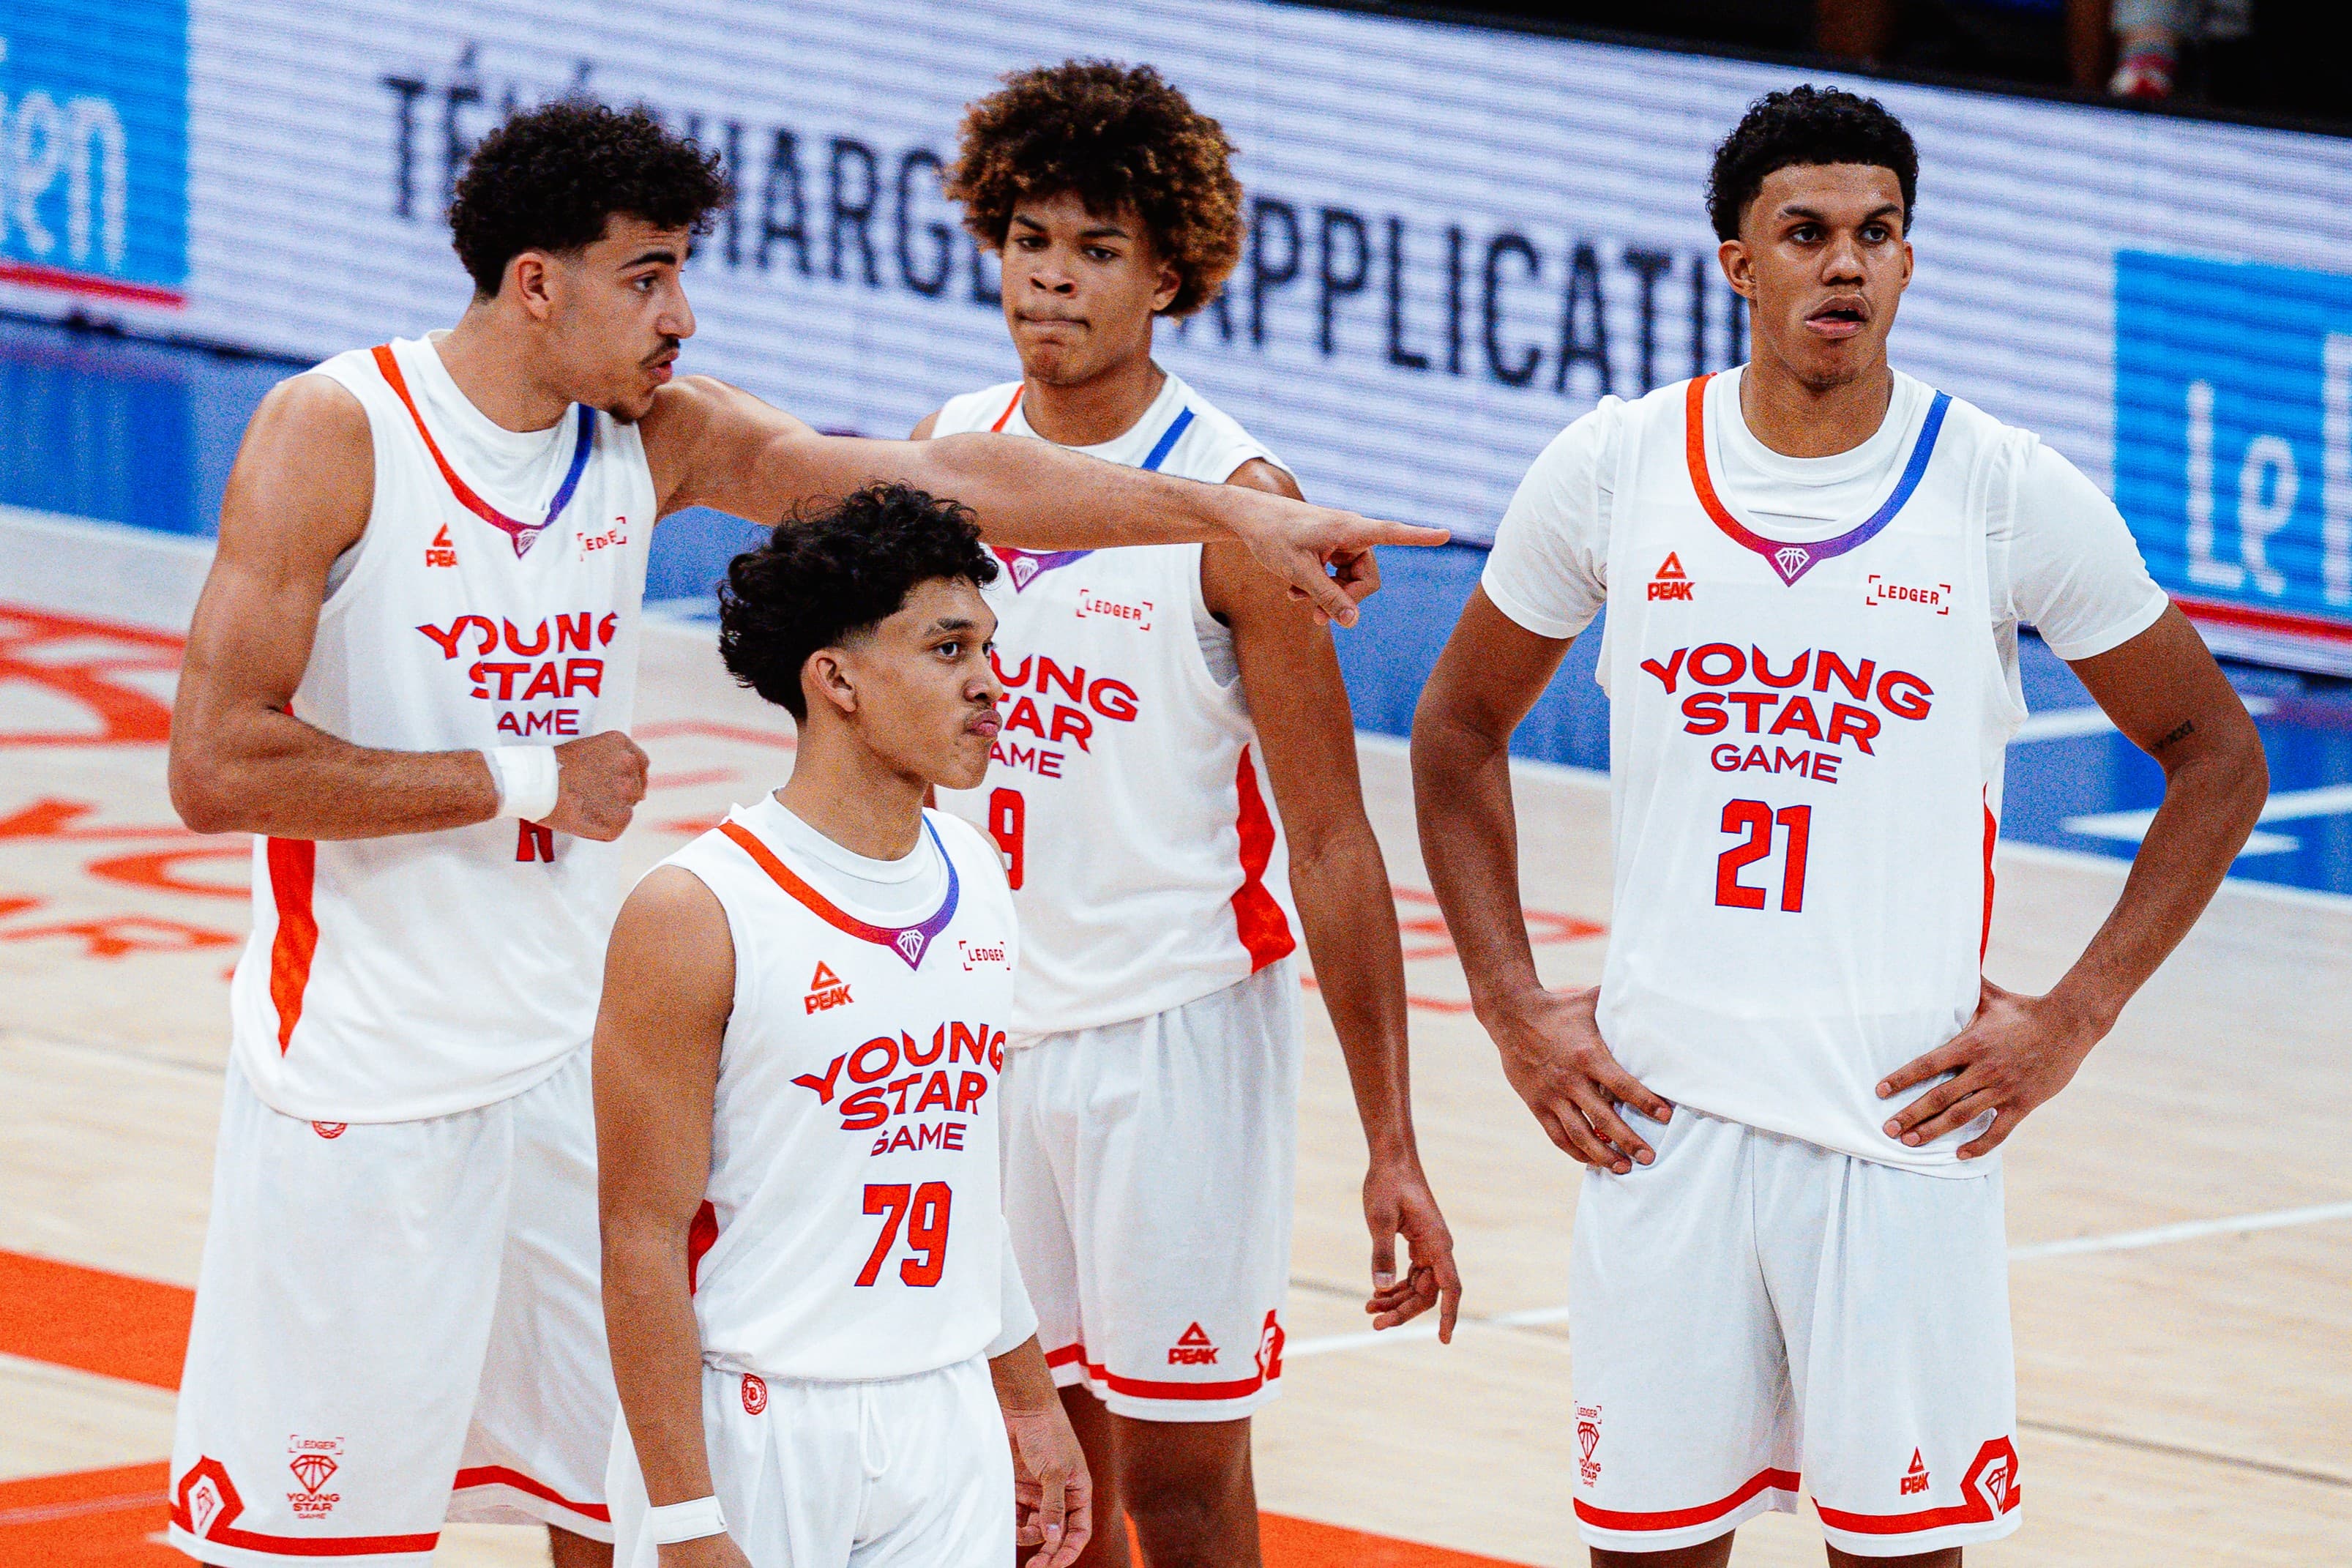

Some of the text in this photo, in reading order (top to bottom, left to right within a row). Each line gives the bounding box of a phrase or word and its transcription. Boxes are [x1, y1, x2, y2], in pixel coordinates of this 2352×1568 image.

[2187, 378, 2299, 597] Le
[1648, 582, 1695, 602] PEAK
[1878, 584, 1941, 606] LEDGER
[1085, 598, 1142, 621] LEDGER
[990, 649, 1140, 723] UNG
[1640, 642, 1935, 721] YOUNG
[496, 708, 580, 736] AME
[1681, 691, 1883, 757] STAR
[989, 740, 1065, 778] AME
[1711, 744, 1843, 785] GAME
[1714, 798, 1812, 914] 21
[968, 949, 1005, 961] LEDGER
[804, 984, 855, 1015] PEAK
[839, 1070, 988, 1131] STAR
[854, 1181, 953, 1288] 79
[1168, 1347, 1220, 1365] PEAK
[1577, 1407, 1597, 1419] LEDGER
[296, 1440, 336, 1450] LEDGER
[1579, 1457, 1602, 1472] YOUNG
[1581, 1468, 1597, 1482] STAR
[1900, 1471, 1931, 1496] PEAK
[287, 1493, 340, 1502] YOUNG
[293, 1503, 333, 1512] STAR
